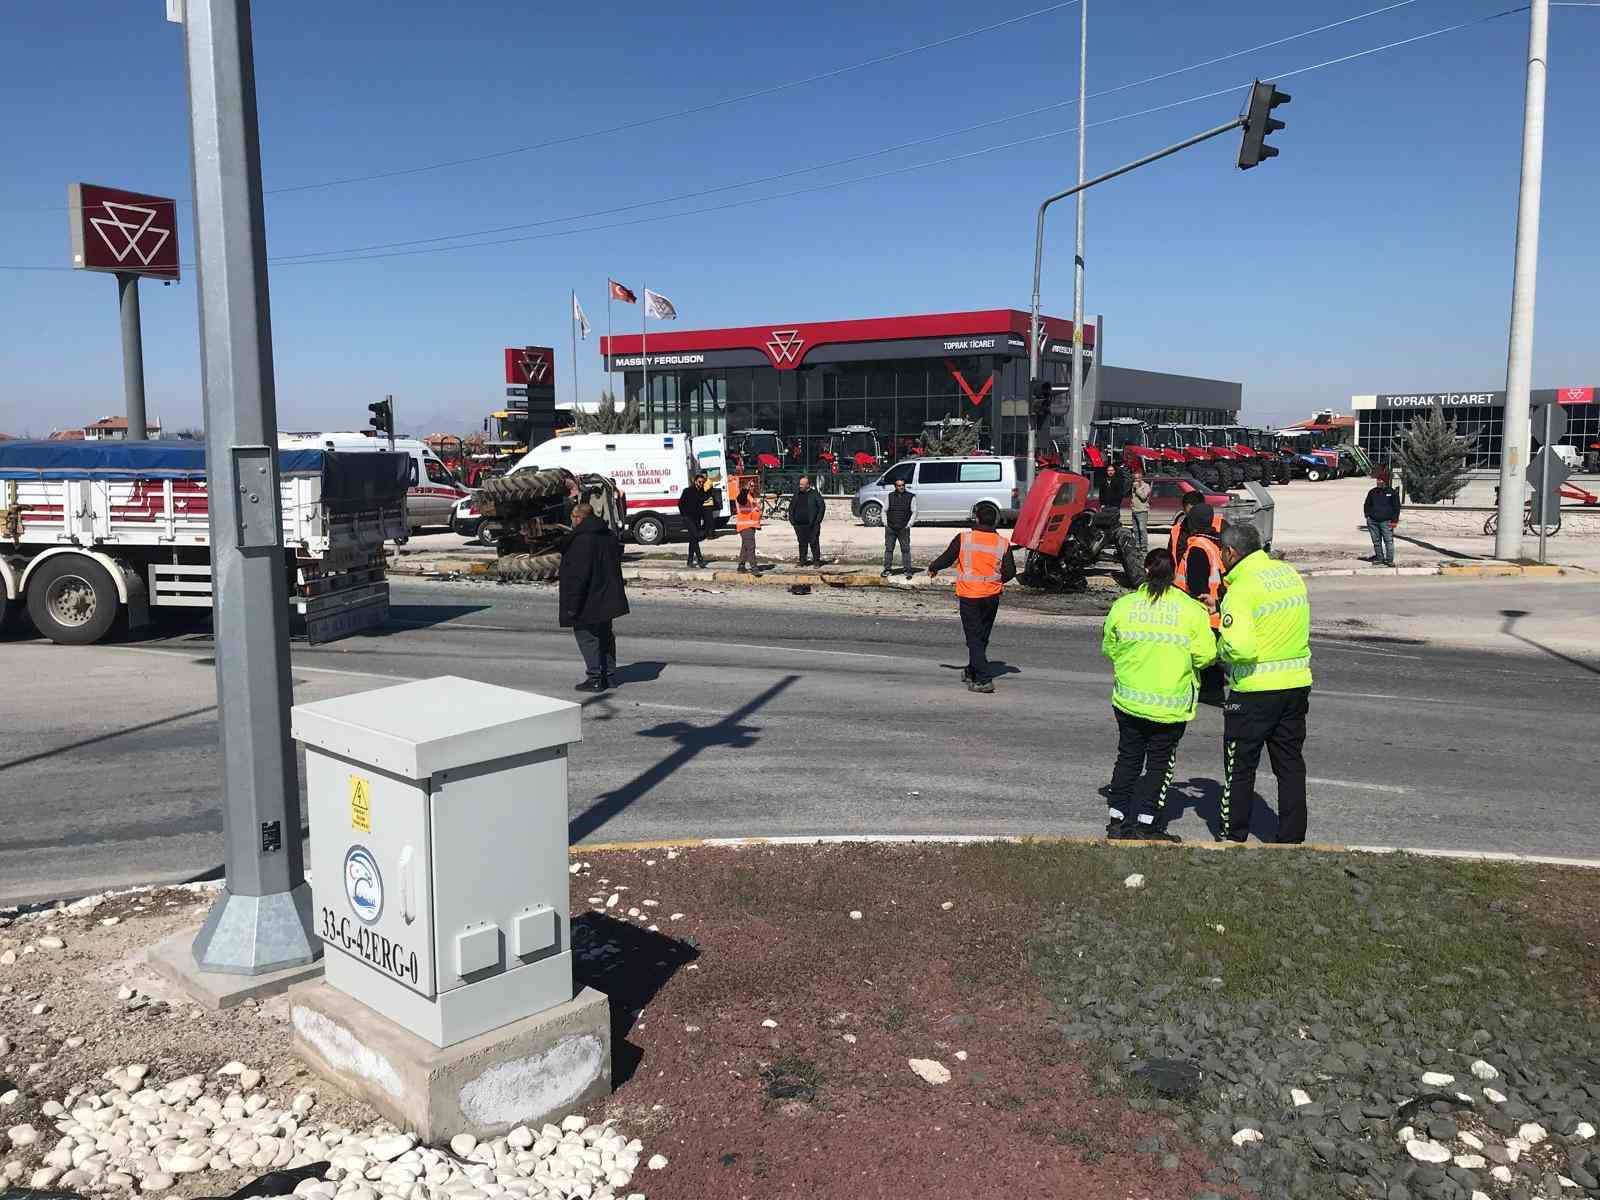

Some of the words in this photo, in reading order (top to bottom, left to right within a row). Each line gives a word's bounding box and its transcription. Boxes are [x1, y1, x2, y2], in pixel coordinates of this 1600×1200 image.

[943, 341, 968, 350] TOPRAK
[615, 357, 653, 367] MASSEY
[654, 354, 704, 365] FERGUSON
[1386, 395, 1435, 407] TOPRAK
[1439, 392, 1494, 406] TİCARET
[322, 907, 418, 984] 33-G-42ERG-0
